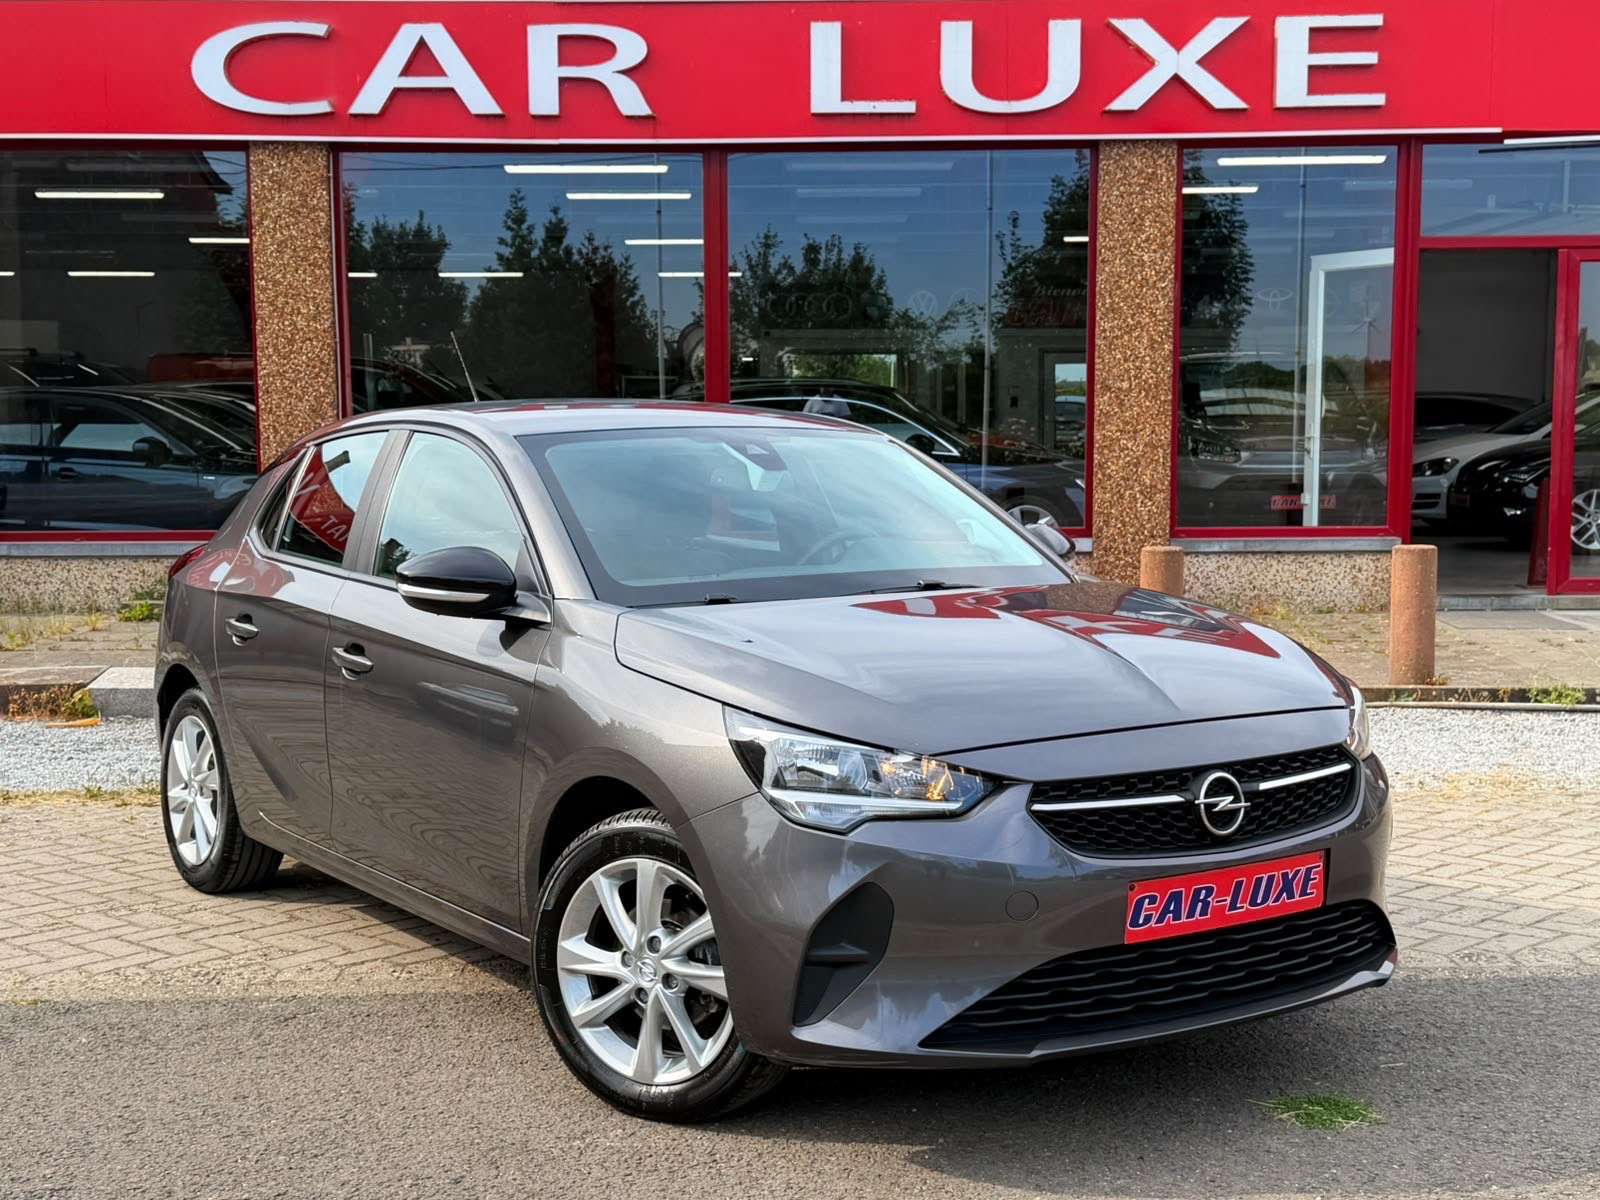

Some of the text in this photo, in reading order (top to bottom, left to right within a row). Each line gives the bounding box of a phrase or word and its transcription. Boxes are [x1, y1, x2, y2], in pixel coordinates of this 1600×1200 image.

[191, 14, 1386, 117] CAR LUXE
[1128, 863, 1322, 929] CAR-LUXE
